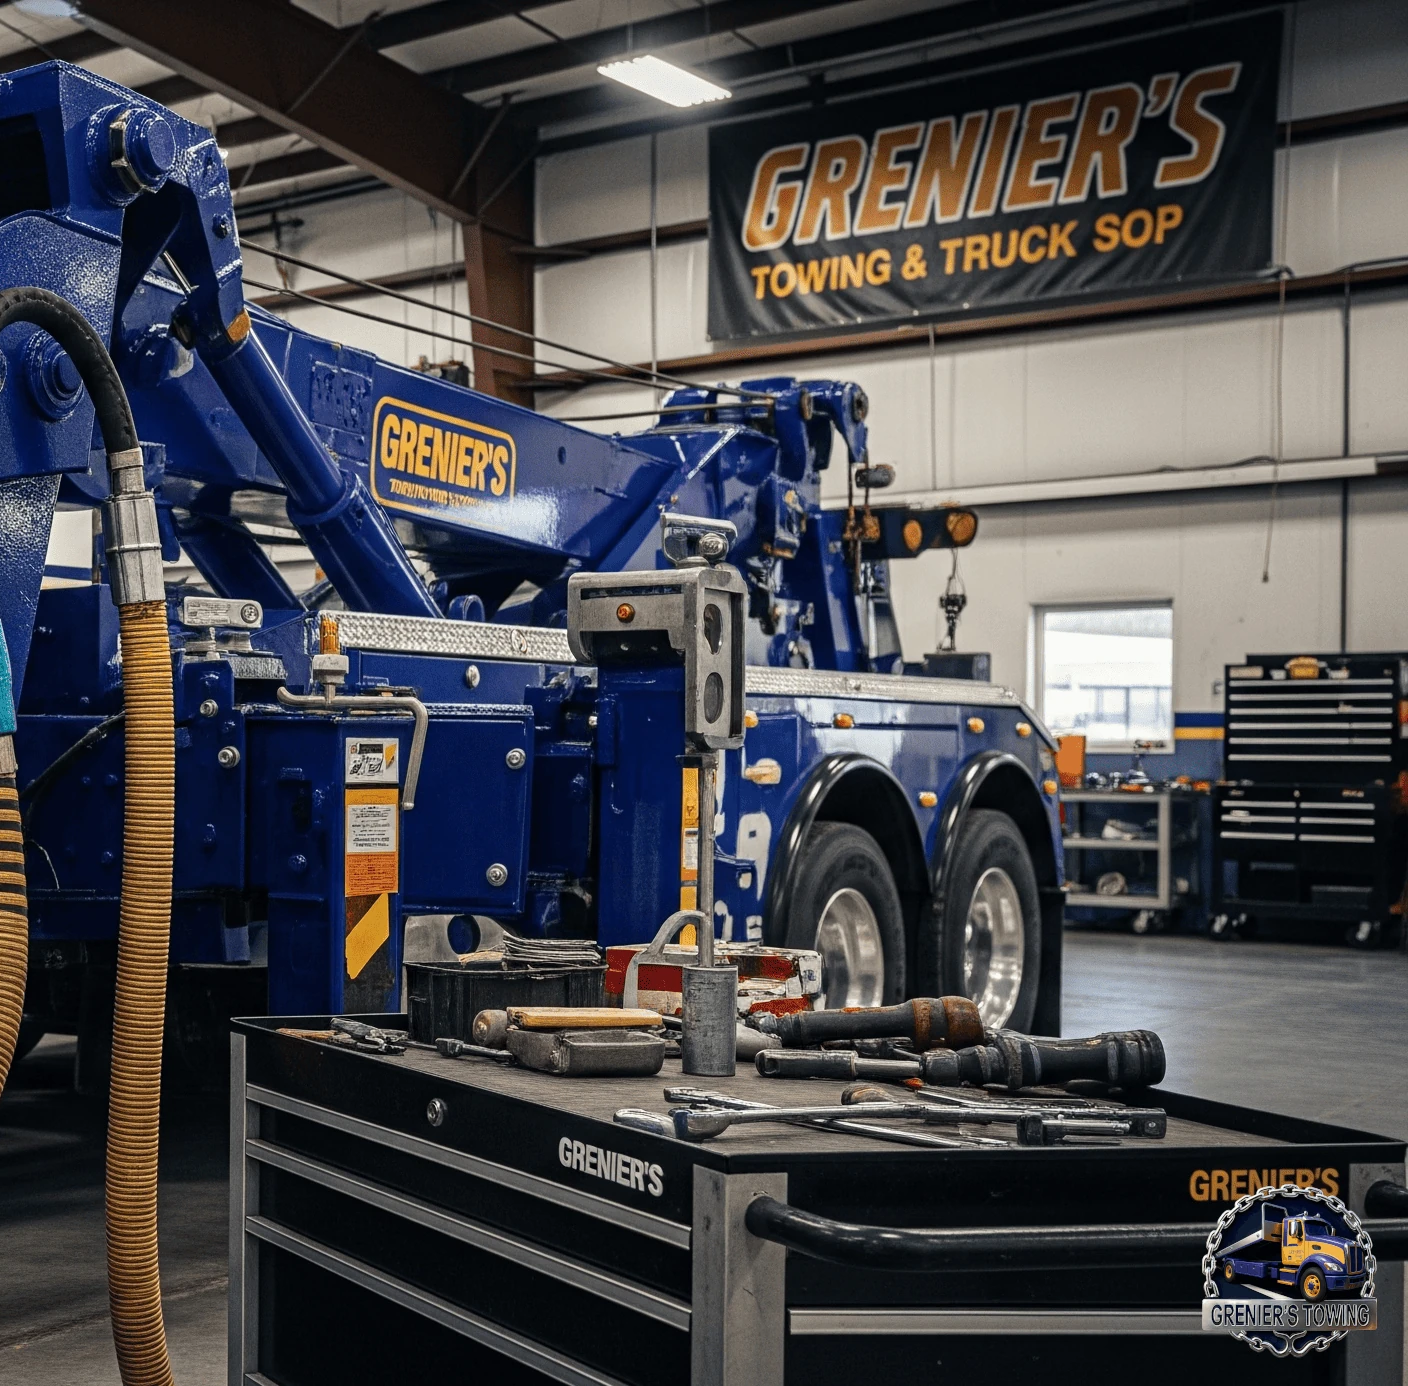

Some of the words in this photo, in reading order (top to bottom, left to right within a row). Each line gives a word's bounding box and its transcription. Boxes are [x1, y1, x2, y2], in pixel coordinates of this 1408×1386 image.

[743, 62, 1243, 252] GRENIER'S
[751, 248, 892, 300] TOWING
[901, 244, 928, 281] &
[939, 220, 1079, 275] TRUCK
[1093, 204, 1184, 253] SOP
[380, 413, 509, 497] GRENIER'S
[558, 1136, 664, 1197] GRENIER'S
